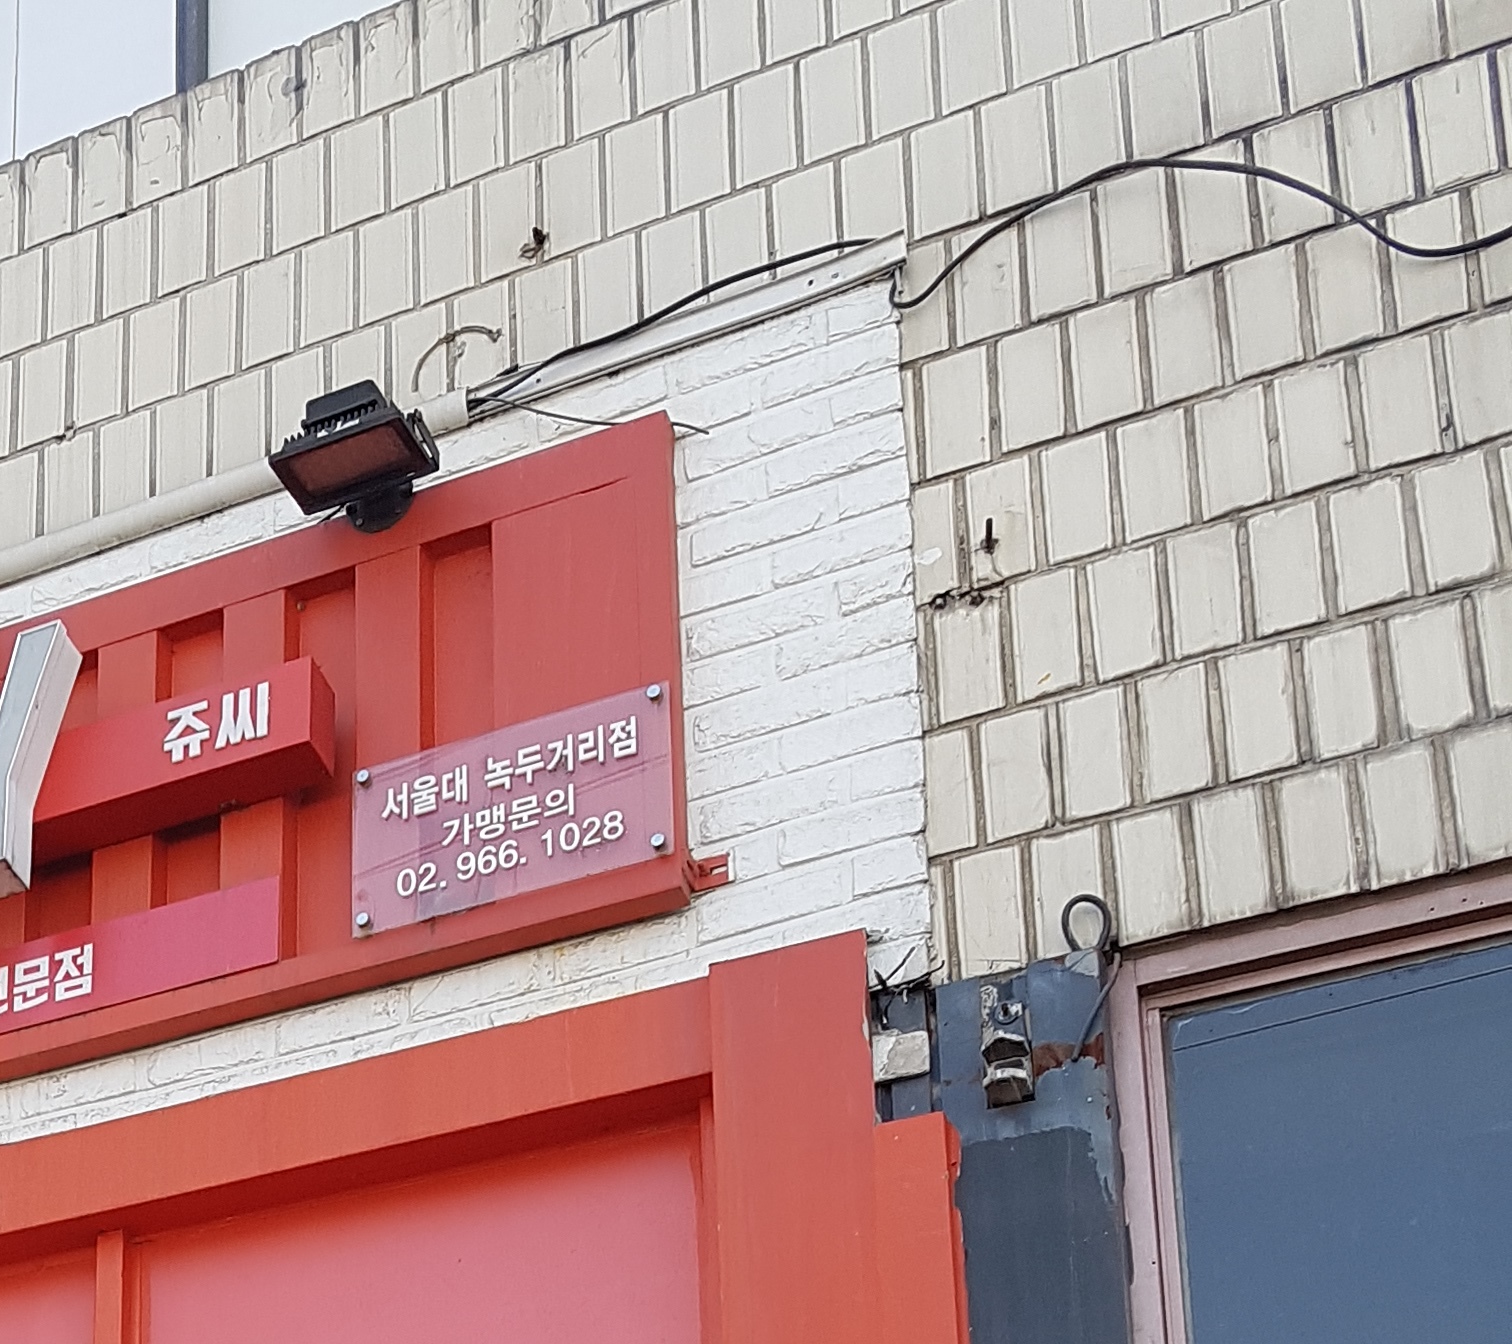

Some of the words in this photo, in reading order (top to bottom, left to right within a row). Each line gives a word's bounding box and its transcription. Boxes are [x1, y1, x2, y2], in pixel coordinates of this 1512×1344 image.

[163, 681, 270, 763] 쥬씨
[381, 764, 469, 822] 서울대
[483, 716, 638, 788] 녹두거리점
[396, 862, 448, 898] 02.
[456, 841, 527, 881] 966.
[541, 811, 625, 858] 1028
[441, 784, 576, 849] 가맹문의
